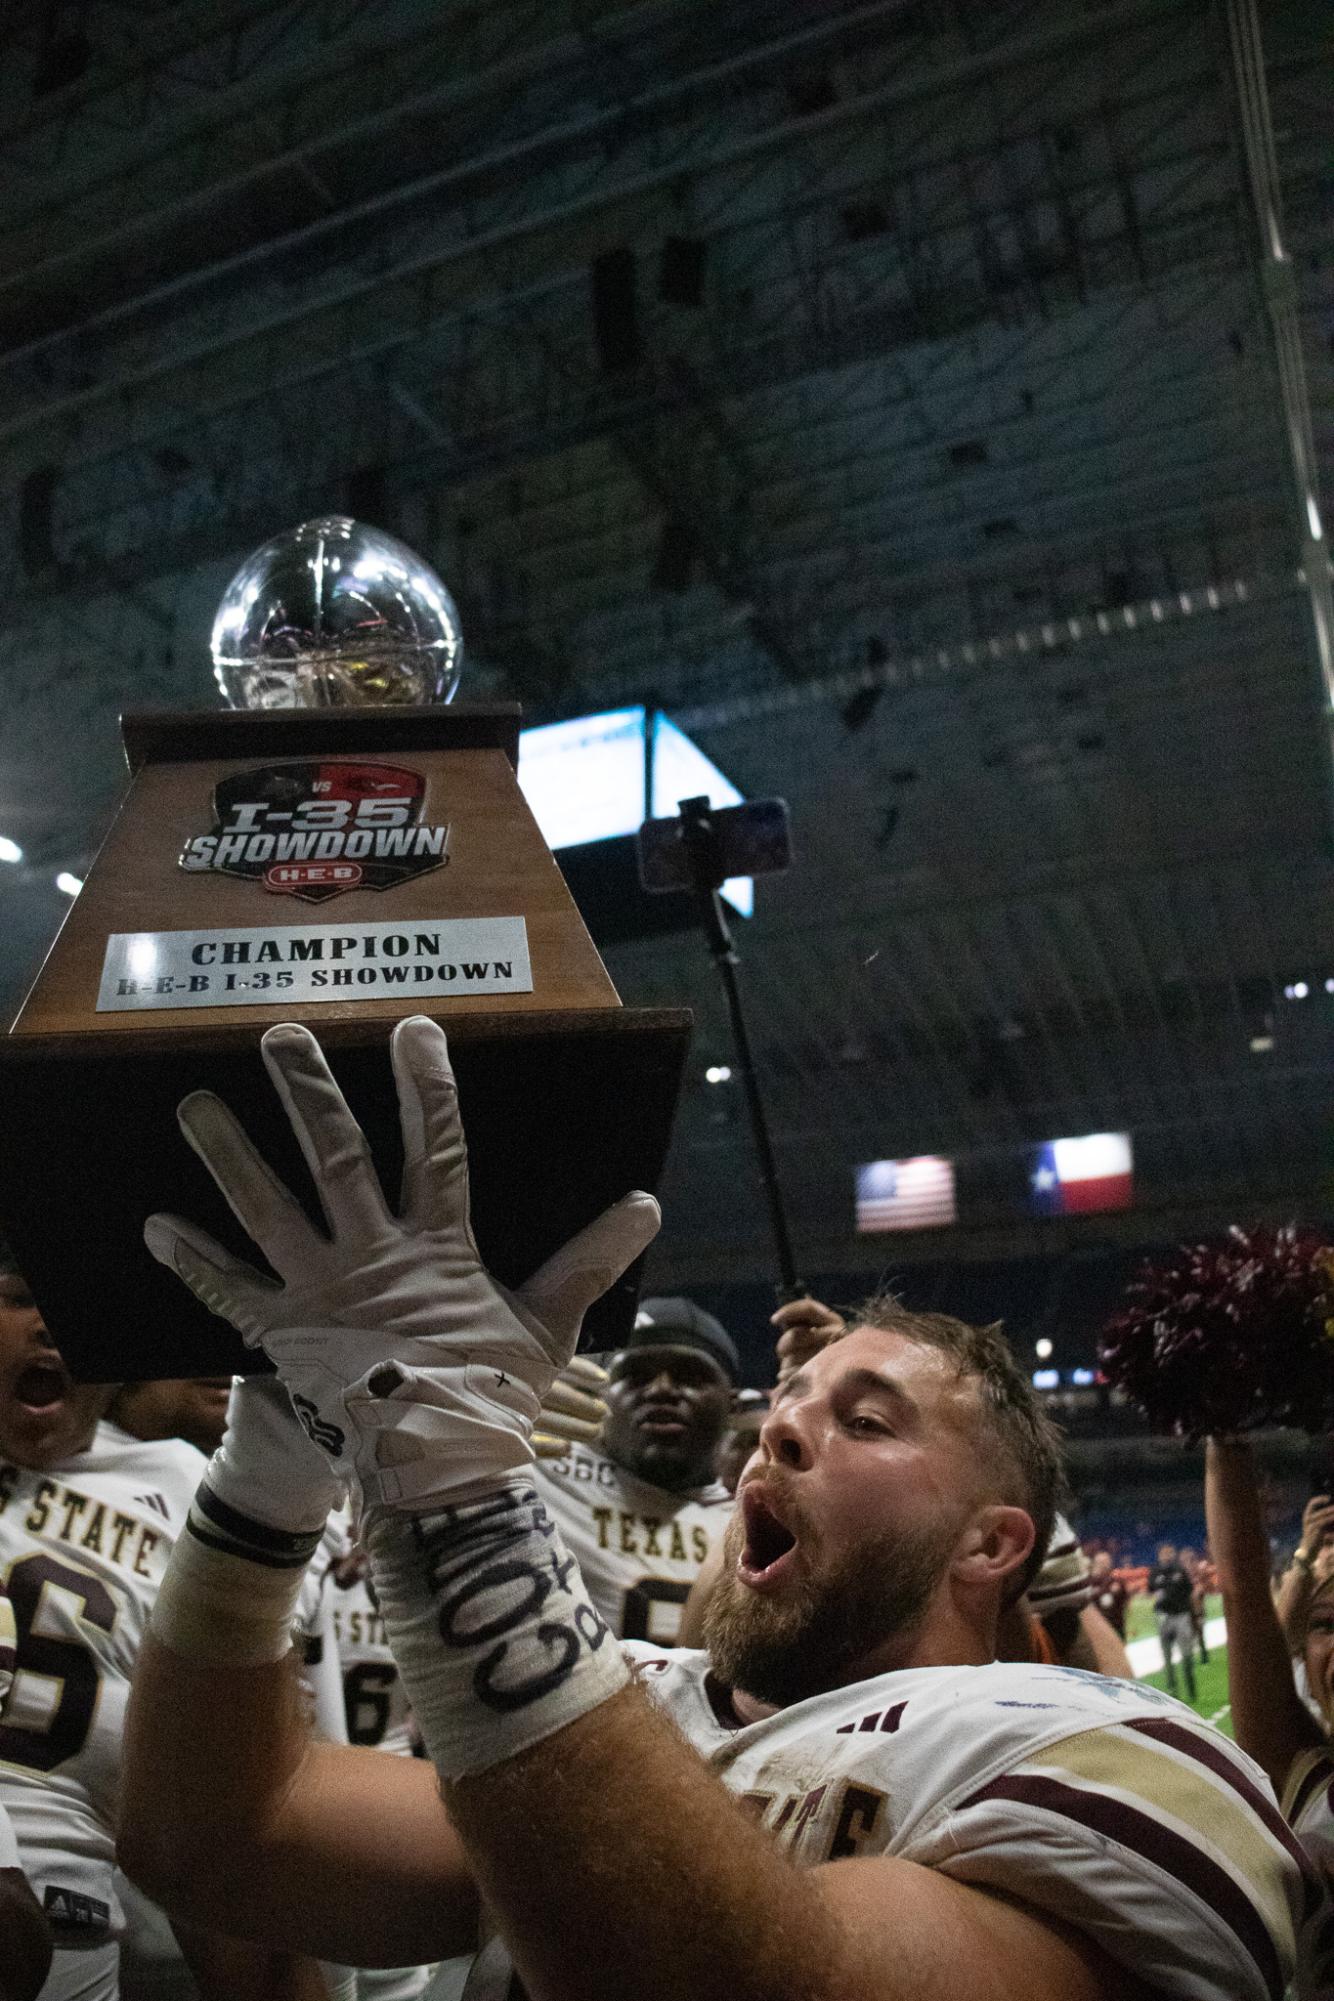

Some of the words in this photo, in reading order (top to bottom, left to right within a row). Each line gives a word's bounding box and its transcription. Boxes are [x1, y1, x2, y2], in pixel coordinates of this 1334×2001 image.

[222, 797, 413, 834] I-35
[185, 826, 447, 869] SHOWDOWN
[191, 932, 442, 967] CHAMPION
[115, 973, 211, 997] H-E-B
[310, 961, 514, 987] SHOWDOWN
[25, 1478, 159, 1579] STATE
[592, 1506, 709, 1564] TEXAS
[343, 1663, 398, 1746] 6
